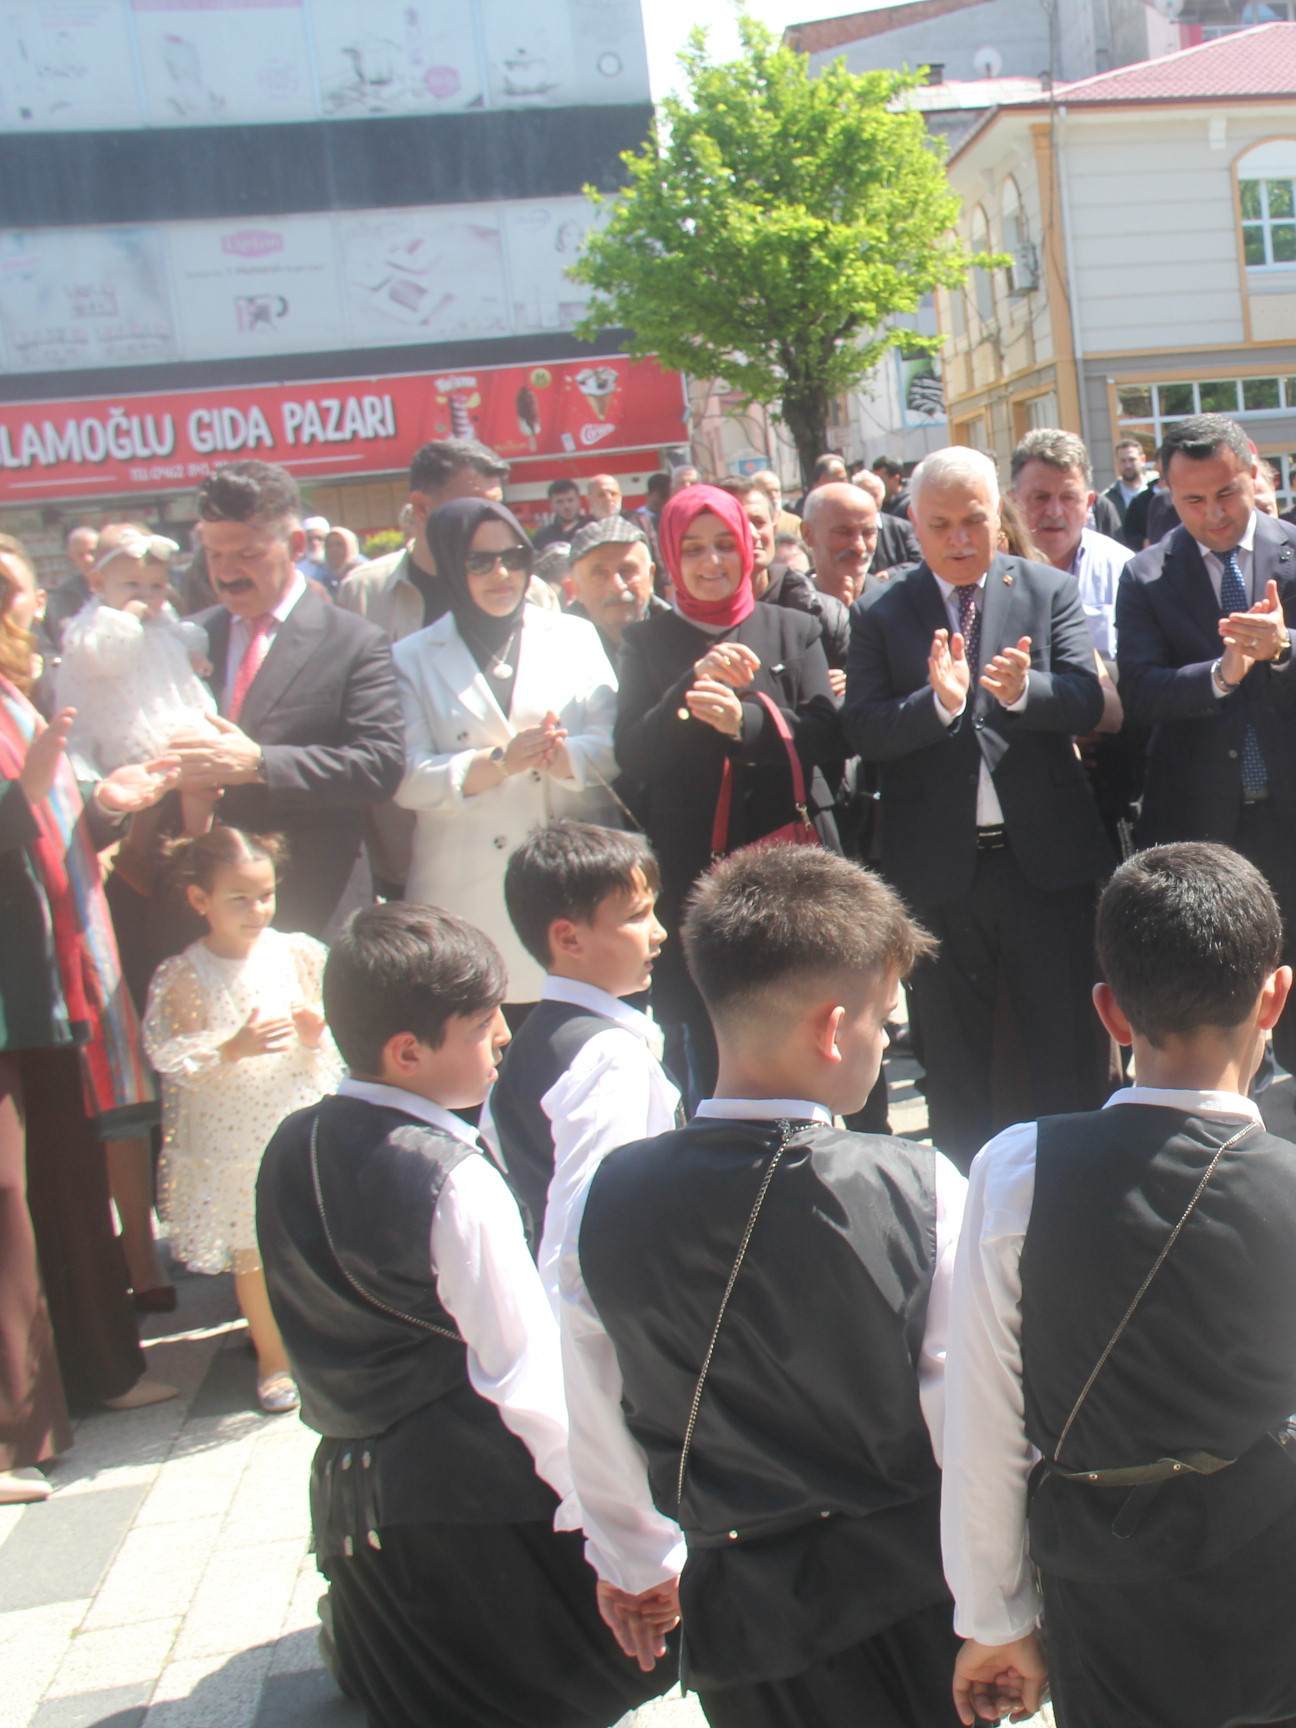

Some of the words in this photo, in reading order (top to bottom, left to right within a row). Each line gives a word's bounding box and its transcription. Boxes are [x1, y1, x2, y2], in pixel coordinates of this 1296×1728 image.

[0, 406, 175, 468] LAMOĞLU
[187, 408, 275, 453] GIDA
[281, 394, 396, 445] PAZARI
